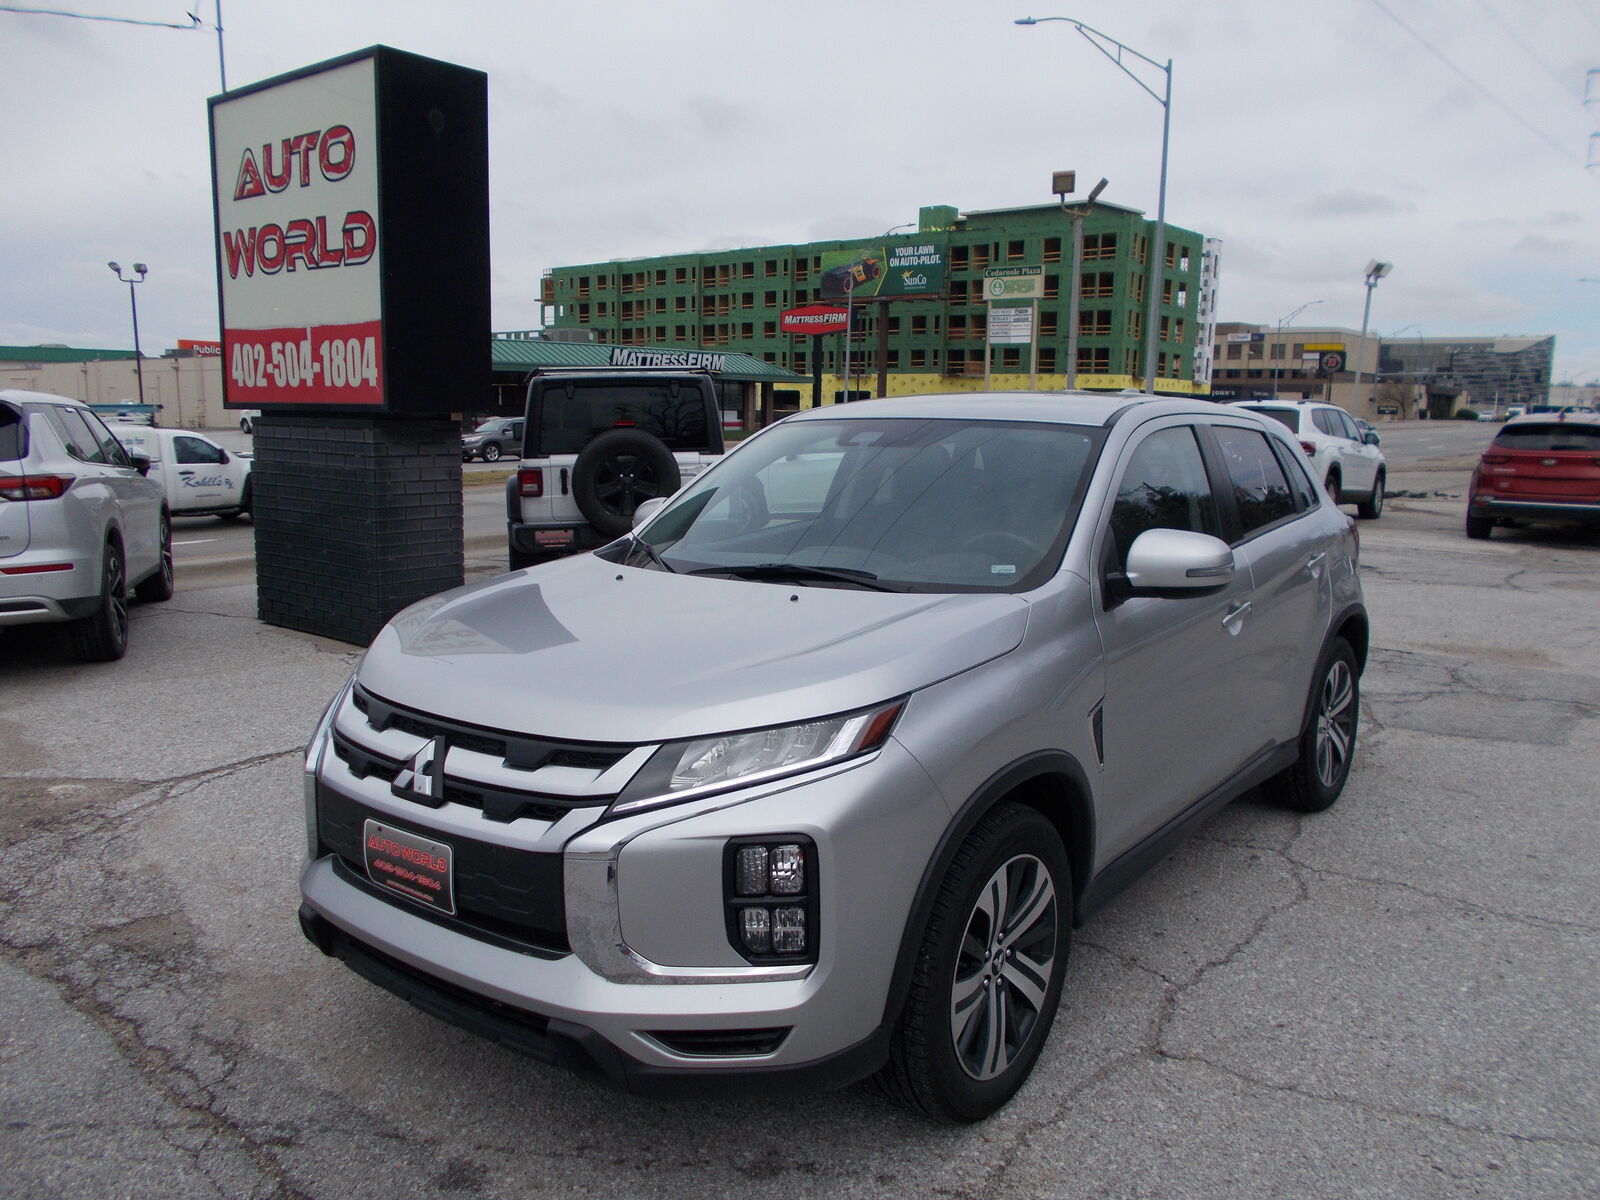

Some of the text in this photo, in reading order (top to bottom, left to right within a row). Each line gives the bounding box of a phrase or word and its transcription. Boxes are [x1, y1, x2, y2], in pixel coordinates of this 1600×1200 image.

[233, 125, 356, 201] AUTO
[223, 210, 377, 280] WORLD
[895, 244, 935, 257] YOUR LAWN
[889, 254, 942, 267] ON AUTO-PILOT.
[1021, 267, 1041, 275] Plaza
[903, 273, 927, 286] SunCo
[231, 336, 378, 388] 402-504-1804
[367, 833, 448, 873] AUTO WORLD
